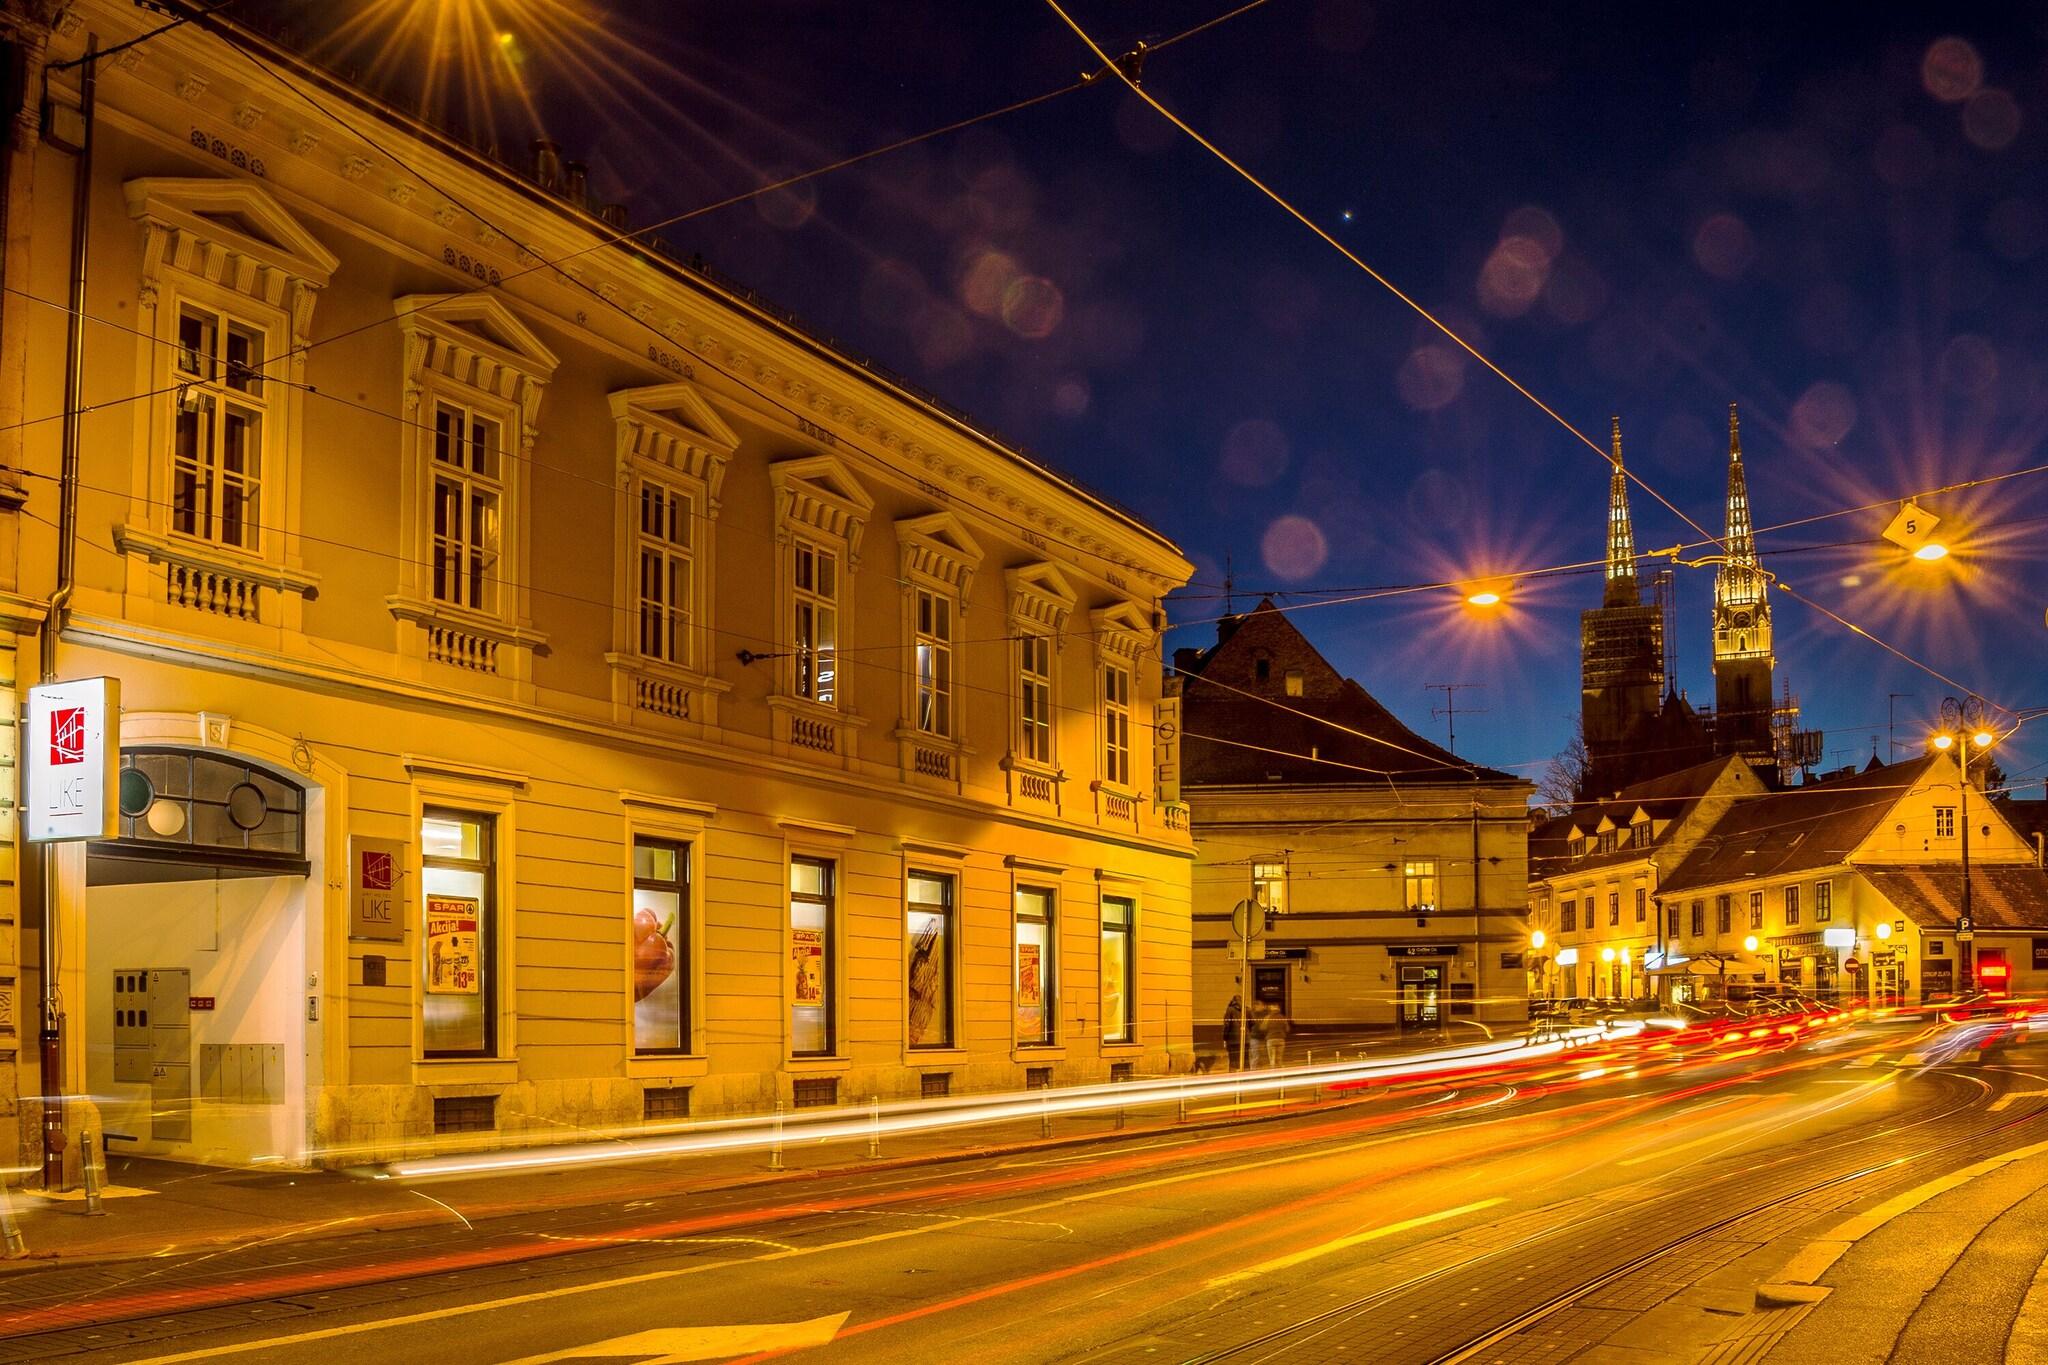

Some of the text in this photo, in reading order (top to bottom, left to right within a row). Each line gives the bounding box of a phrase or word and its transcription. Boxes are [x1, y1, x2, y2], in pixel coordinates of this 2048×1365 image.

[1907, 520, 1916, 534] 5
[1158, 702, 1176, 802] HOTEL
[49, 777, 85, 809] LIKE
[362, 898, 391, 920] LIKE
[434, 903, 464, 912] SPAR
[430, 920, 460, 934] Akcija!
[1961, 920, 1969, 930] P
